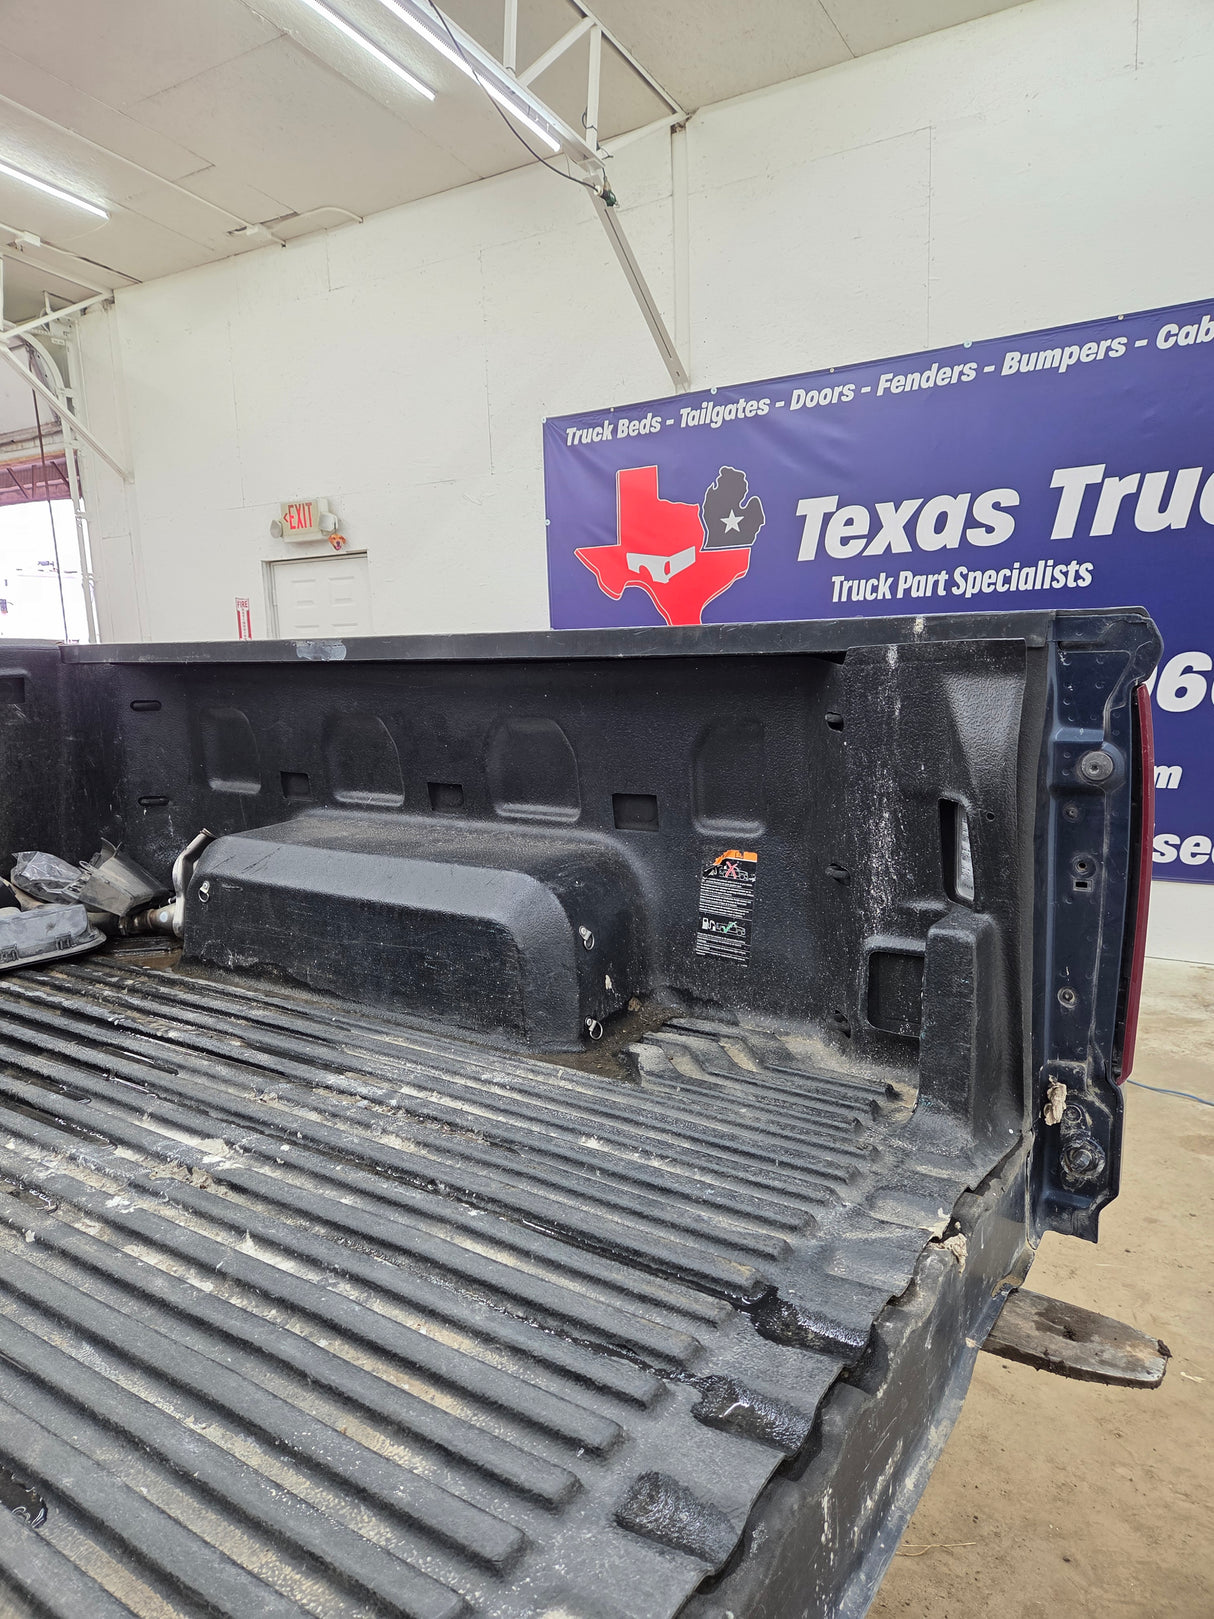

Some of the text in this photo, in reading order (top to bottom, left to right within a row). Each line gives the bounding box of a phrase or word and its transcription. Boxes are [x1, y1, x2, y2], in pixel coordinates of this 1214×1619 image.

[565, 420, 613, 446] Truck
[616, 412, 662, 439] Beds
[679, 397, 771, 429] Tailgates
[789, 383, 856, 411] Doors
[876, 362, 978, 397] Fenders
[1000, 336, 1128, 376] Bumpers
[288, 502, 312, 529] EXIT
[795, 488, 1020, 563] Texas
[831, 560, 1094, 603] Truck Part Specialists
[237, 600, 248, 608] FIRE
